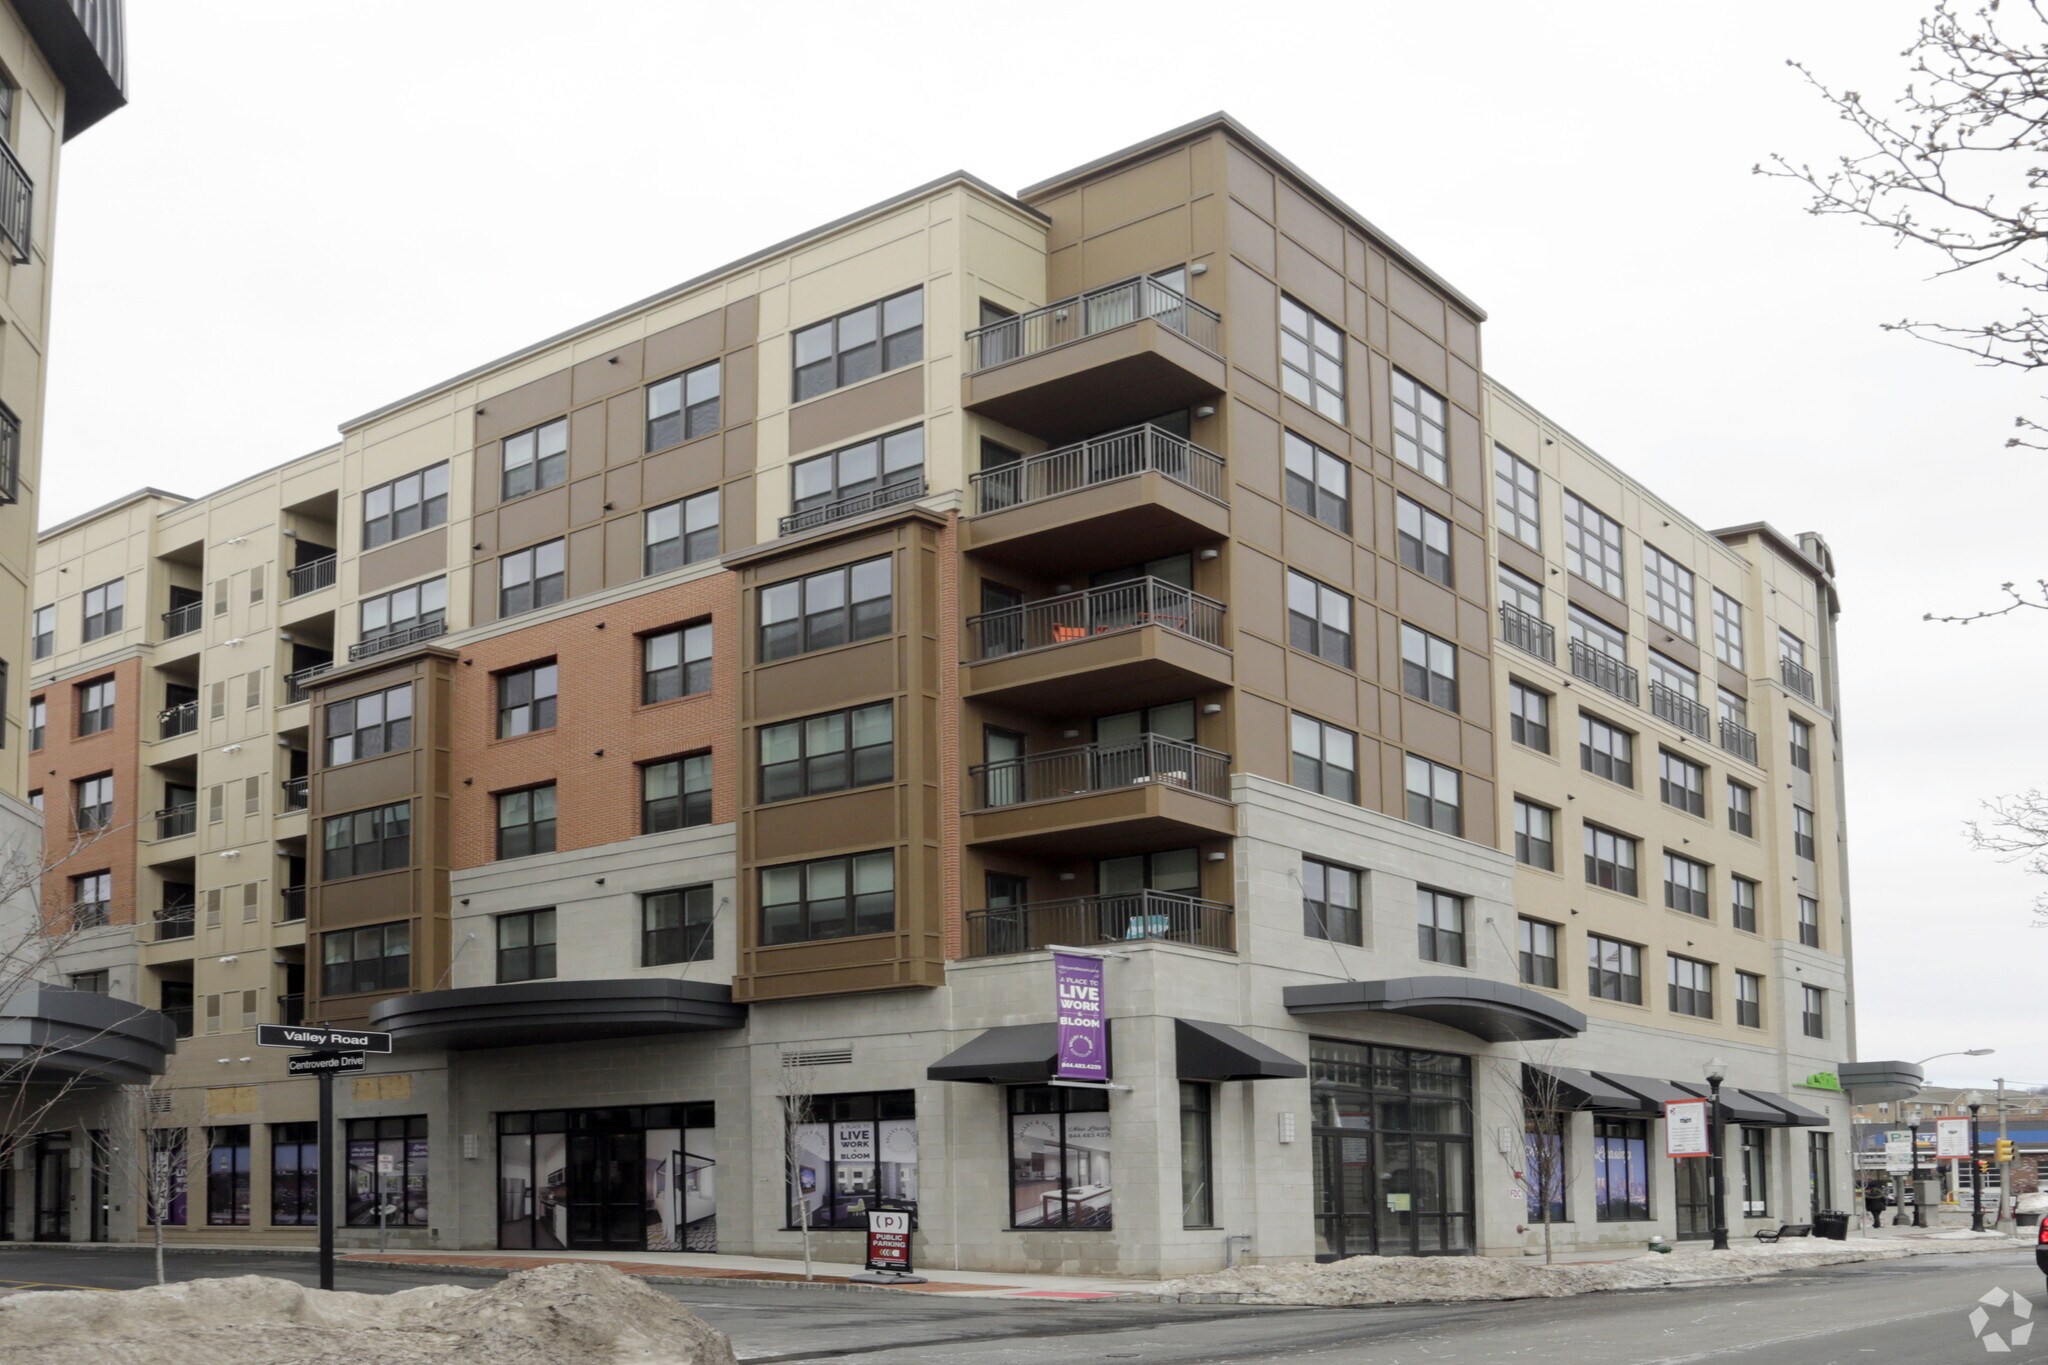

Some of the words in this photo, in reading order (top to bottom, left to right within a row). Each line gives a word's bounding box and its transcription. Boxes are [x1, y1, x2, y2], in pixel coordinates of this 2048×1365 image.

[1060, 984, 1099, 1000] LIVE
[1060, 999, 1100, 1011] WORK
[1060, 1017, 1100, 1028] BLOOM
[284, 1031, 327, 1044] Valley
[331, 1034, 368, 1045] Road
[289, 1058, 339, 1070] Centroverde
[341, 1056, 363, 1066] Drive
[840, 1130, 870, 1140] LIVE
[876, 1233, 903, 1241] PUBLIC
[873, 1240, 906, 1248] PARKING
